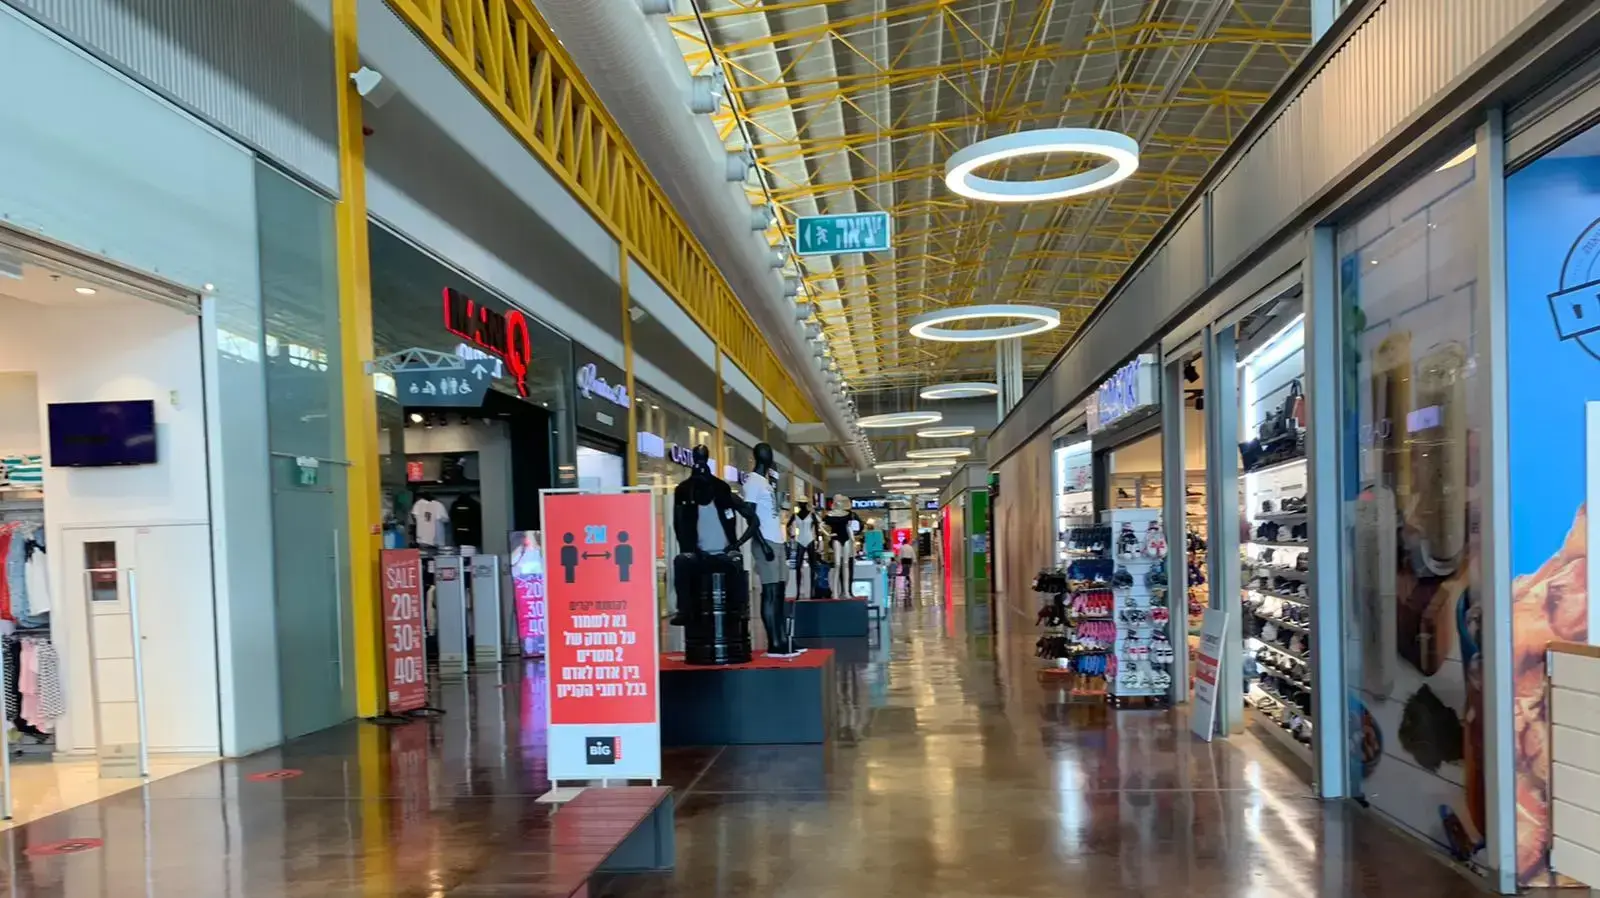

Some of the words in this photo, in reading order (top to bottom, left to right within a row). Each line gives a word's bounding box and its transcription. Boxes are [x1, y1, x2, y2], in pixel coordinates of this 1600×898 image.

[584, 525, 607, 544] 2M
[387, 567, 417, 589] SALE
[391, 593, 412, 620] 20
[392, 624, 412, 652] 30
[615, 647, 624, 662] 2
[394, 656, 414, 684] 40
